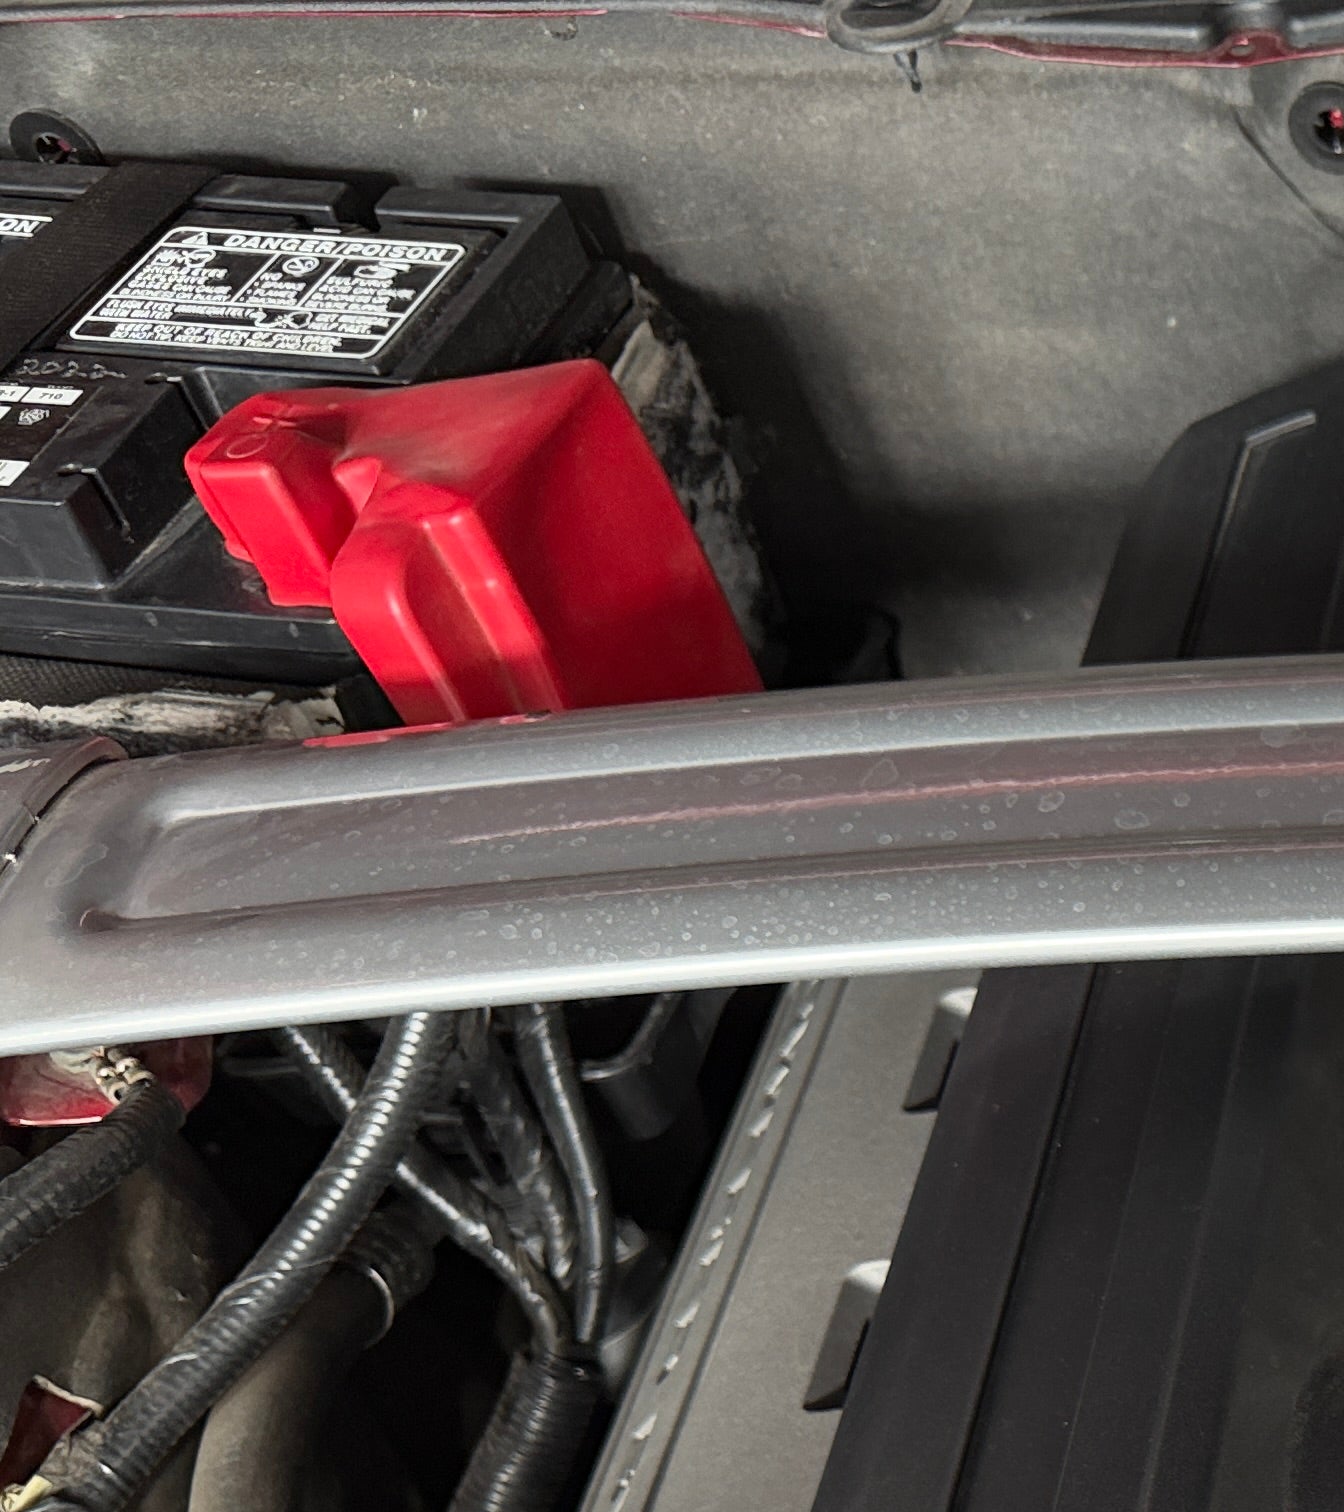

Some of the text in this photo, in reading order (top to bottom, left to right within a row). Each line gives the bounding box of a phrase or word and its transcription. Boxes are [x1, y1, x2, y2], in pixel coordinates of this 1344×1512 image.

[224, 234, 448, 261] DANGER/POISON
[260, 272, 283, 281] NO
[115, 323, 153, 333] KEEP
[154, 324, 184, 334] OUT
[184, 326, 205, 336] OF
